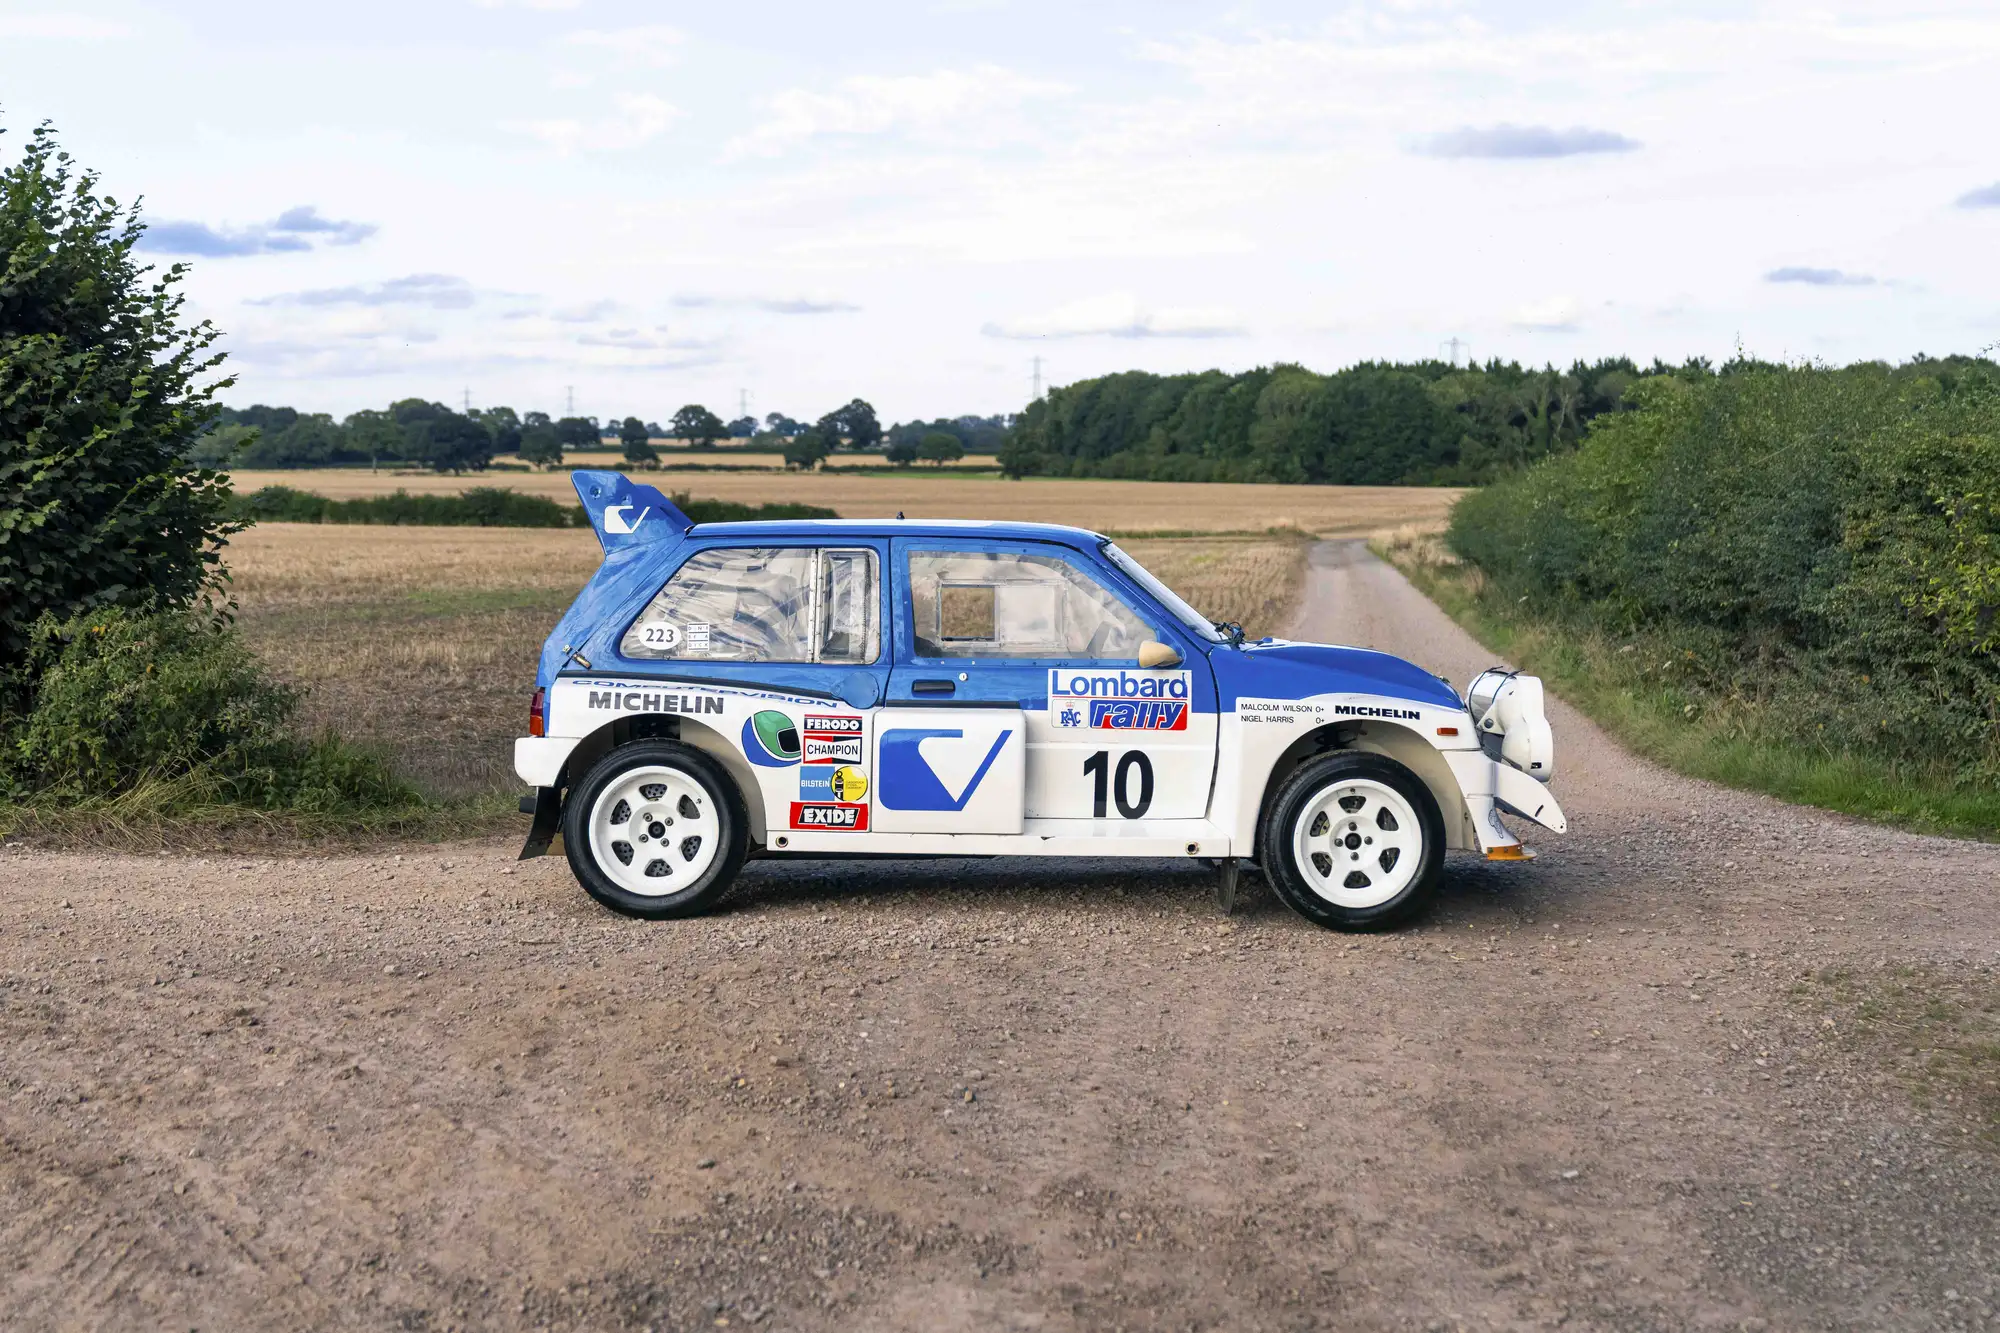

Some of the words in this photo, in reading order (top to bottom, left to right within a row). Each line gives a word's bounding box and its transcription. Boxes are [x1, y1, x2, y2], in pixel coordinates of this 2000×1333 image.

[645, 628, 674, 643] 223
[1052, 670, 1188, 699] Lombard
[588, 691, 725, 714] MICHELIN
[1282, 705, 1313, 713] WILSON
[1060, 708, 1082, 727] RAC
[1091, 701, 1184, 729] rally
[1335, 705, 1420, 720] MICHELIN
[806, 718, 859, 730] FERODO
[807, 744, 858, 755] CHAMPION
[801, 779, 830, 788] BILSTEIN
[1083, 749, 1154, 819] 10
[803, 808, 855, 824] EXIDE
